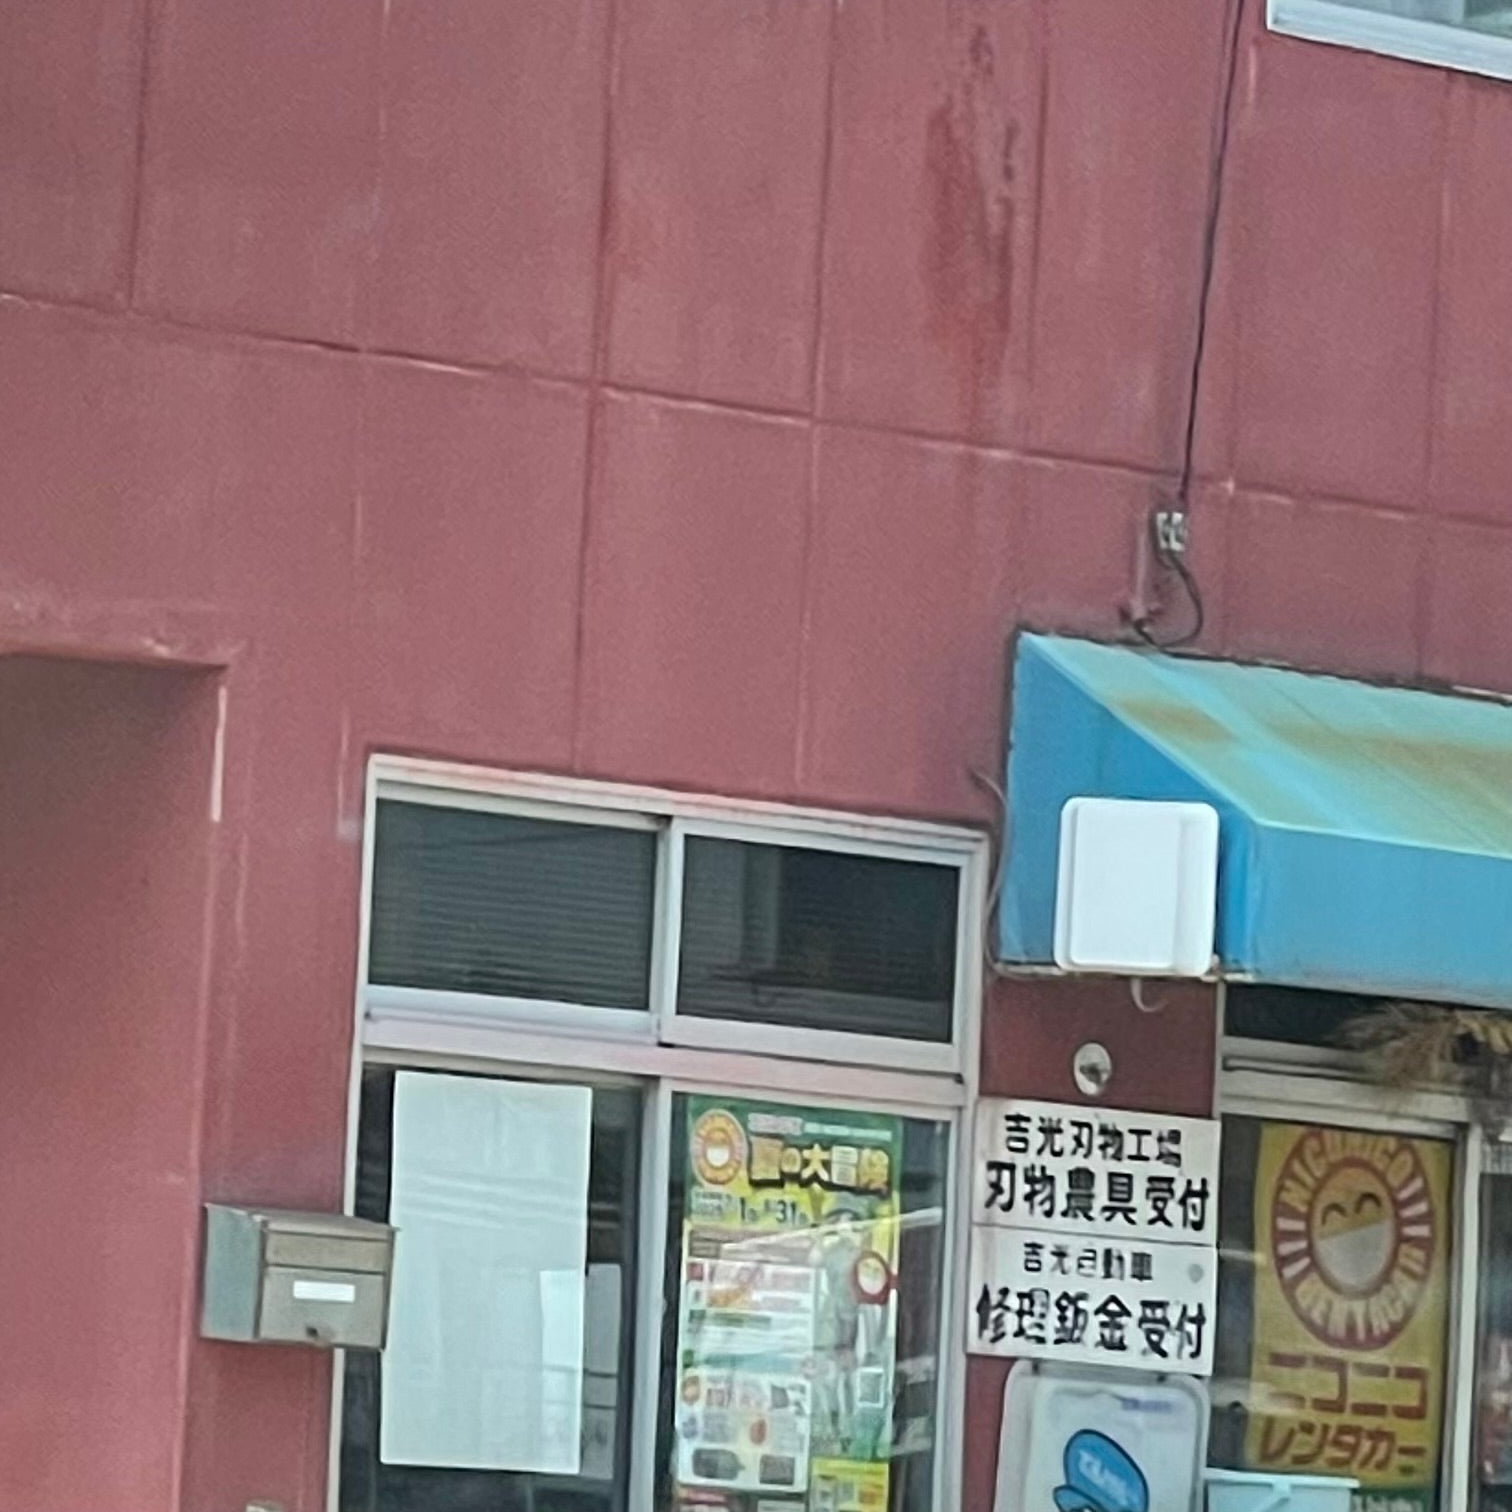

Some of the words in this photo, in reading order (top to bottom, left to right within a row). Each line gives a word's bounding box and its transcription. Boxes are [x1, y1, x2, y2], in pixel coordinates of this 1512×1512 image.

[1004, 1112, 1182, 1167] 吉光刃物工場
[984, 1160, 1209, 1231] 刃物農具受付
[976, 1283, 1206, 1359] 修理鈑金受付
[1267, 1351, 1428, 1420] ニコニコ
[1259, 1414, 1427, 1471] レンタカー
